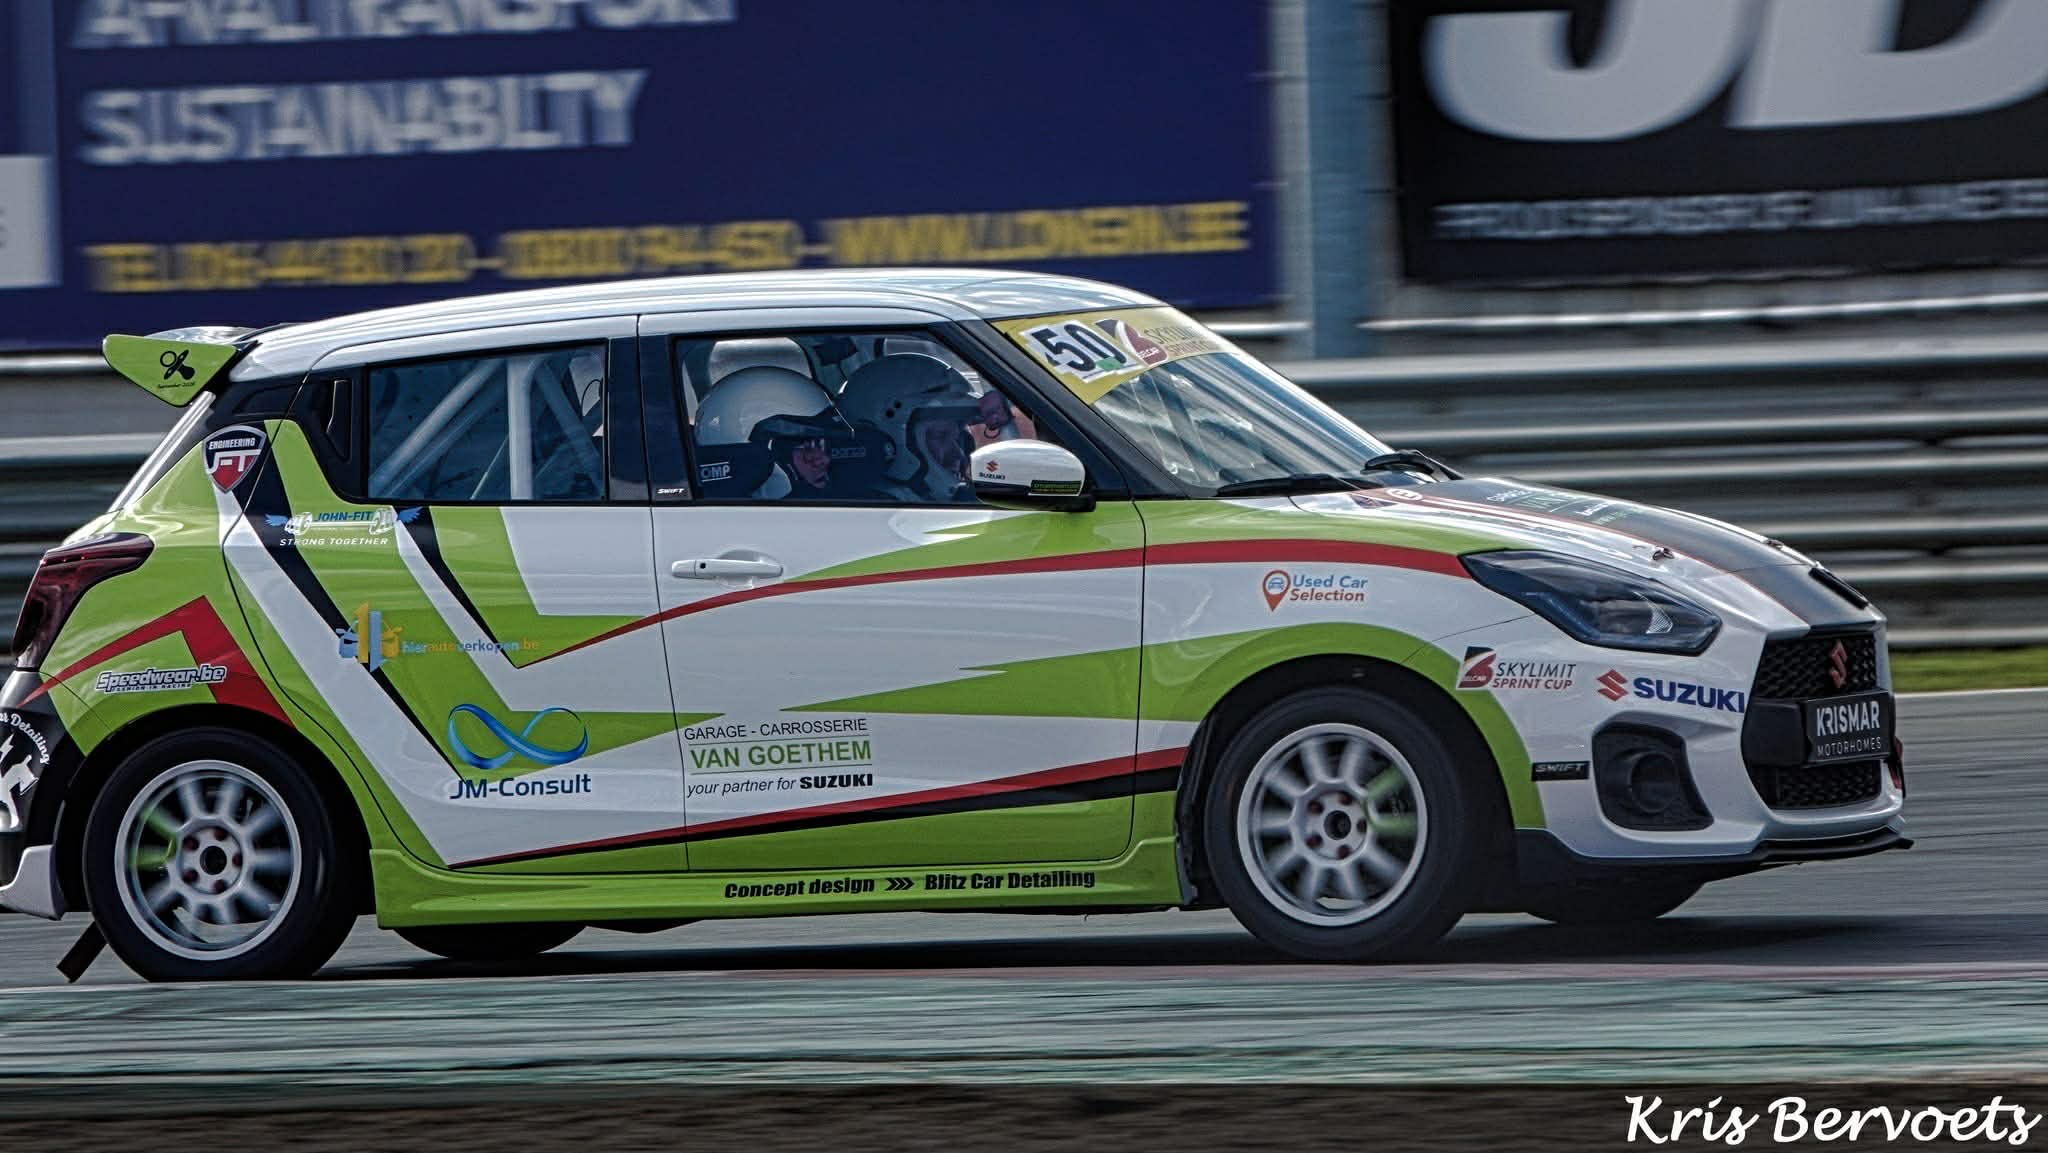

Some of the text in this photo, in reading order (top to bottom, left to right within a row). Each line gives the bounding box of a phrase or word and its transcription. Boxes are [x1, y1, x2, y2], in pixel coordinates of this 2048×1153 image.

[1031, 323, 1127, 372] 50
[208, 437, 256, 450] ENGINEERING
[979, 472, 1006, 480] SUZUKI
[314, 511, 373, 522] JOHN-FIT
[279, 537, 389, 547] STRONG TOGETHER
[1293, 574, 1368, 588] Used Car
[1290, 588, 1365, 601] Selection
[96, 664, 226, 692] Speedwear.be
[1496, 662, 1577, 678] SKYLIMIT
[1493, 678, 1573, 690] SPRINT CUP
[1633, 677, 1746, 713] SUZUKI
[684, 725, 747, 741] GARAGE
[760, 718, 868, 737] CARROSSERIE
[1816, 700, 1881, 737] KRISMAR
[10, 713, 50, 765] Detailing
[1817, 736, 1882, 758] MOTORHOMES
[690, 740, 872, 769] VAN GOETHEM
[1535, 763, 1585, 773] SWIFT
[450, 774, 592, 800] JM-Consult
[687, 774, 874, 798] your partner for SUZUKI
[724, 870, 1096, 898] Concept design Blitz Car Detailing
